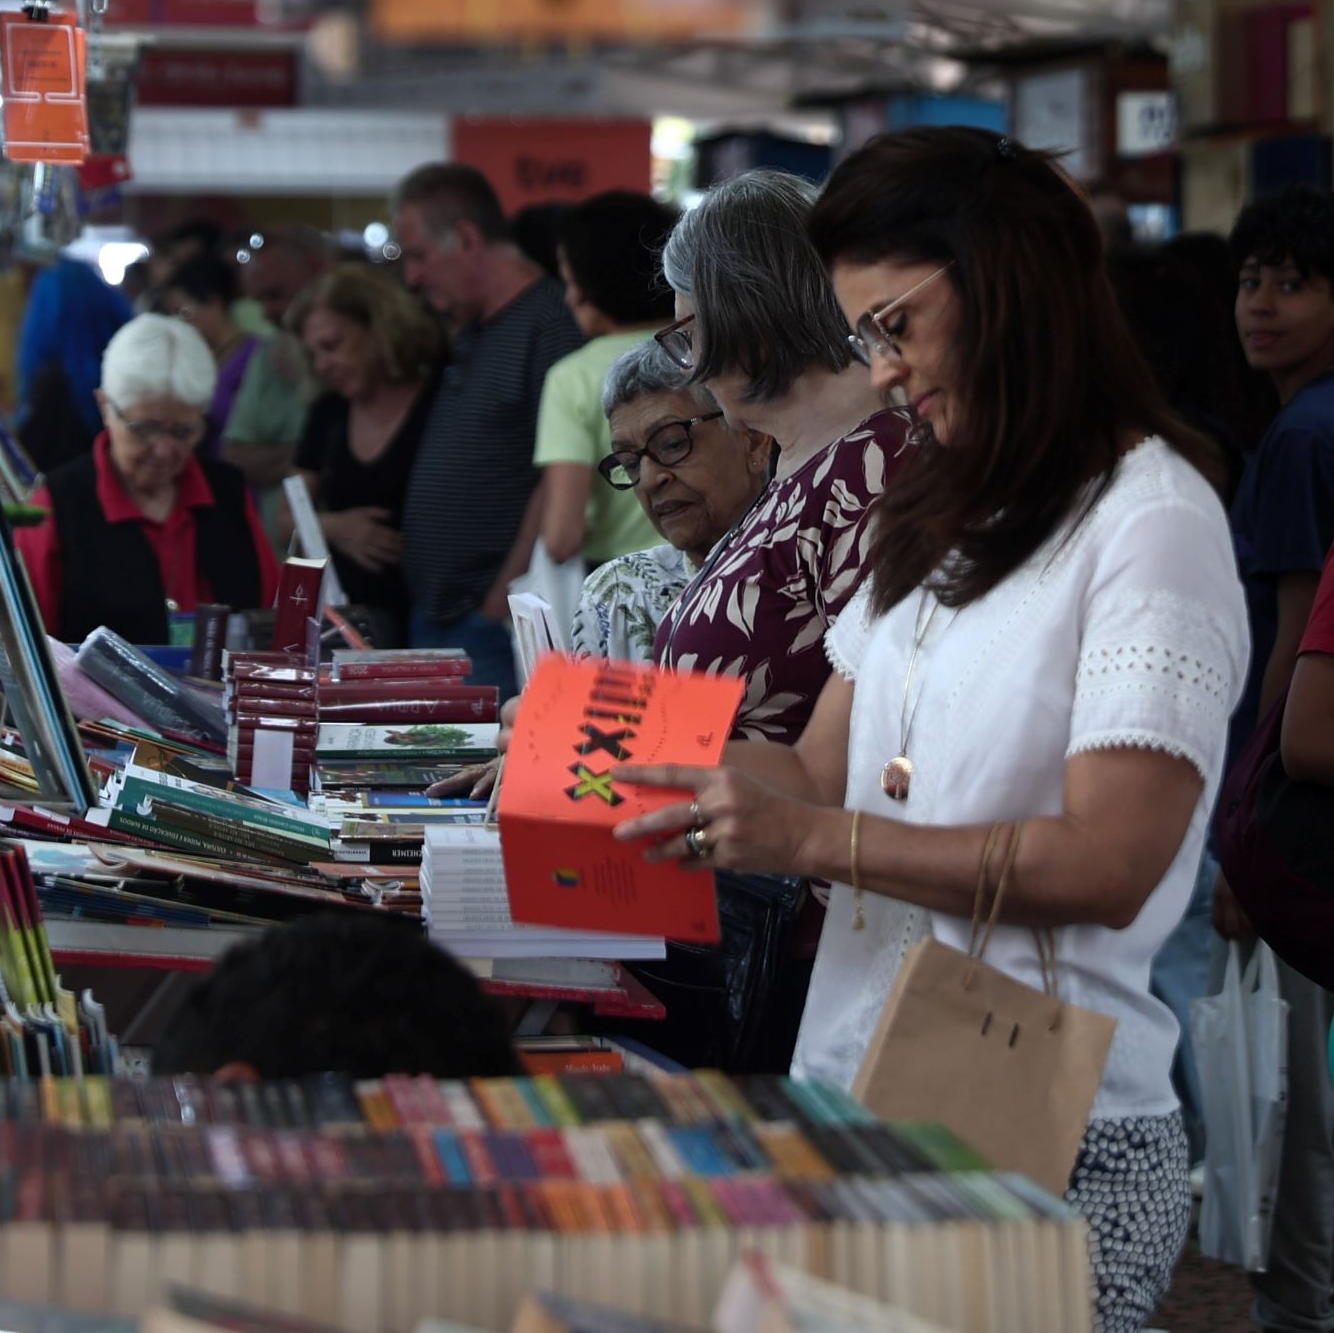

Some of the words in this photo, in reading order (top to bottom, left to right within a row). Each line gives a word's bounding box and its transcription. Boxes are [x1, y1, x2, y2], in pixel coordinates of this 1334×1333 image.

[119, 816, 141, 829] SURDOS
[149, 825, 179, 841] EDUCAÇÃO
[183, 834, 201, 847] PODER
[392, 849, 422, 858] ZHEIMER
